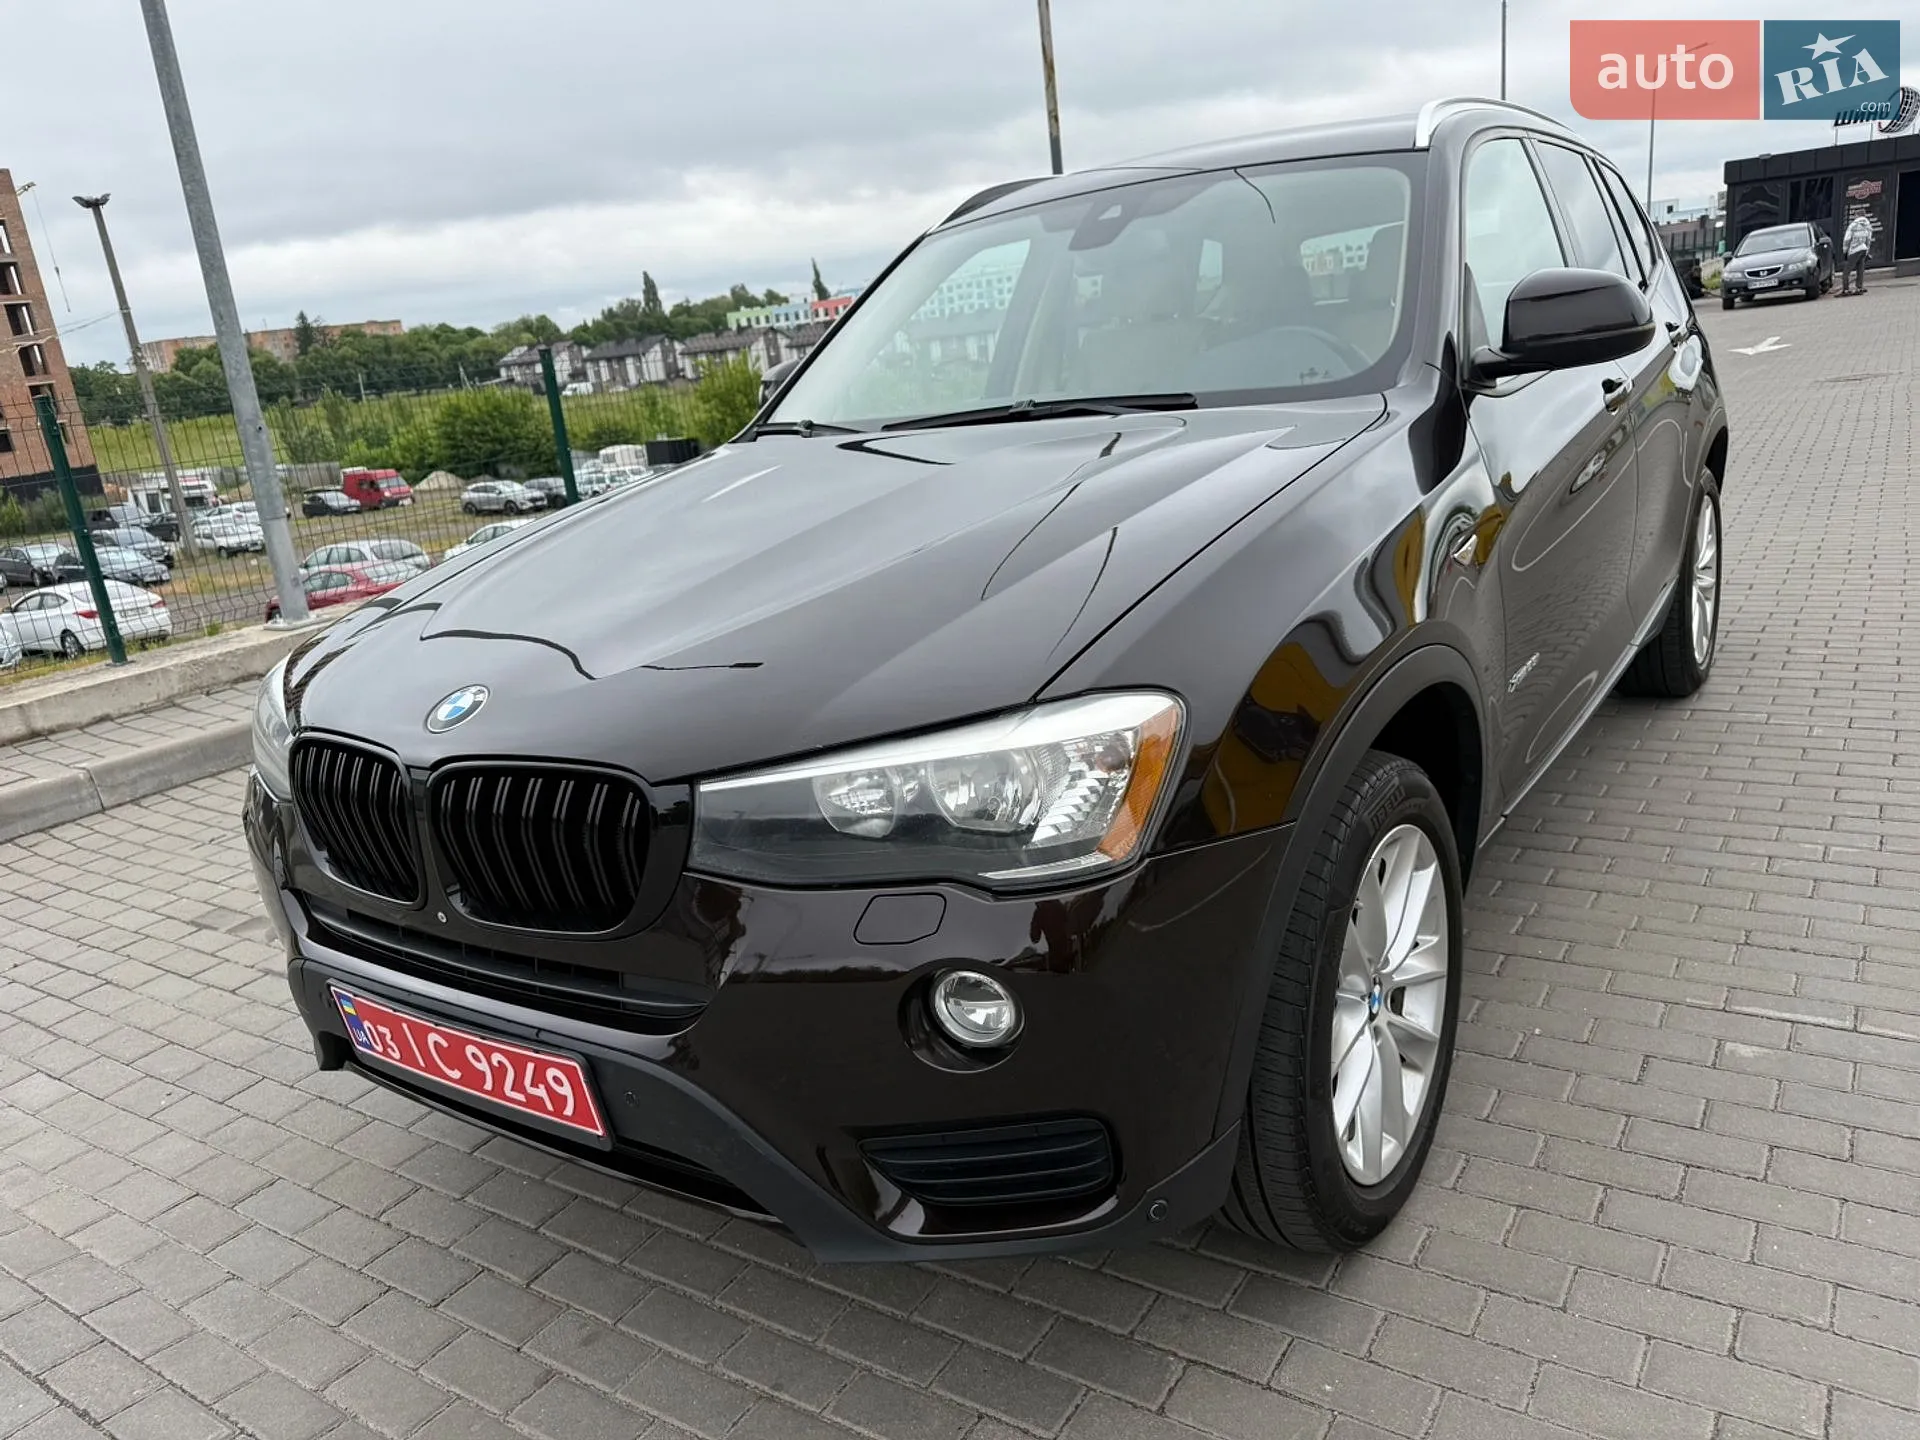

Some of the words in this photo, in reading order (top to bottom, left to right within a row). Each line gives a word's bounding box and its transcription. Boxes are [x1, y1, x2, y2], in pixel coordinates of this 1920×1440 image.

[352, 1027, 371, 1046] UA
[363, 1020, 400, 1060] 03
[465, 1044, 574, 1117] 9249
